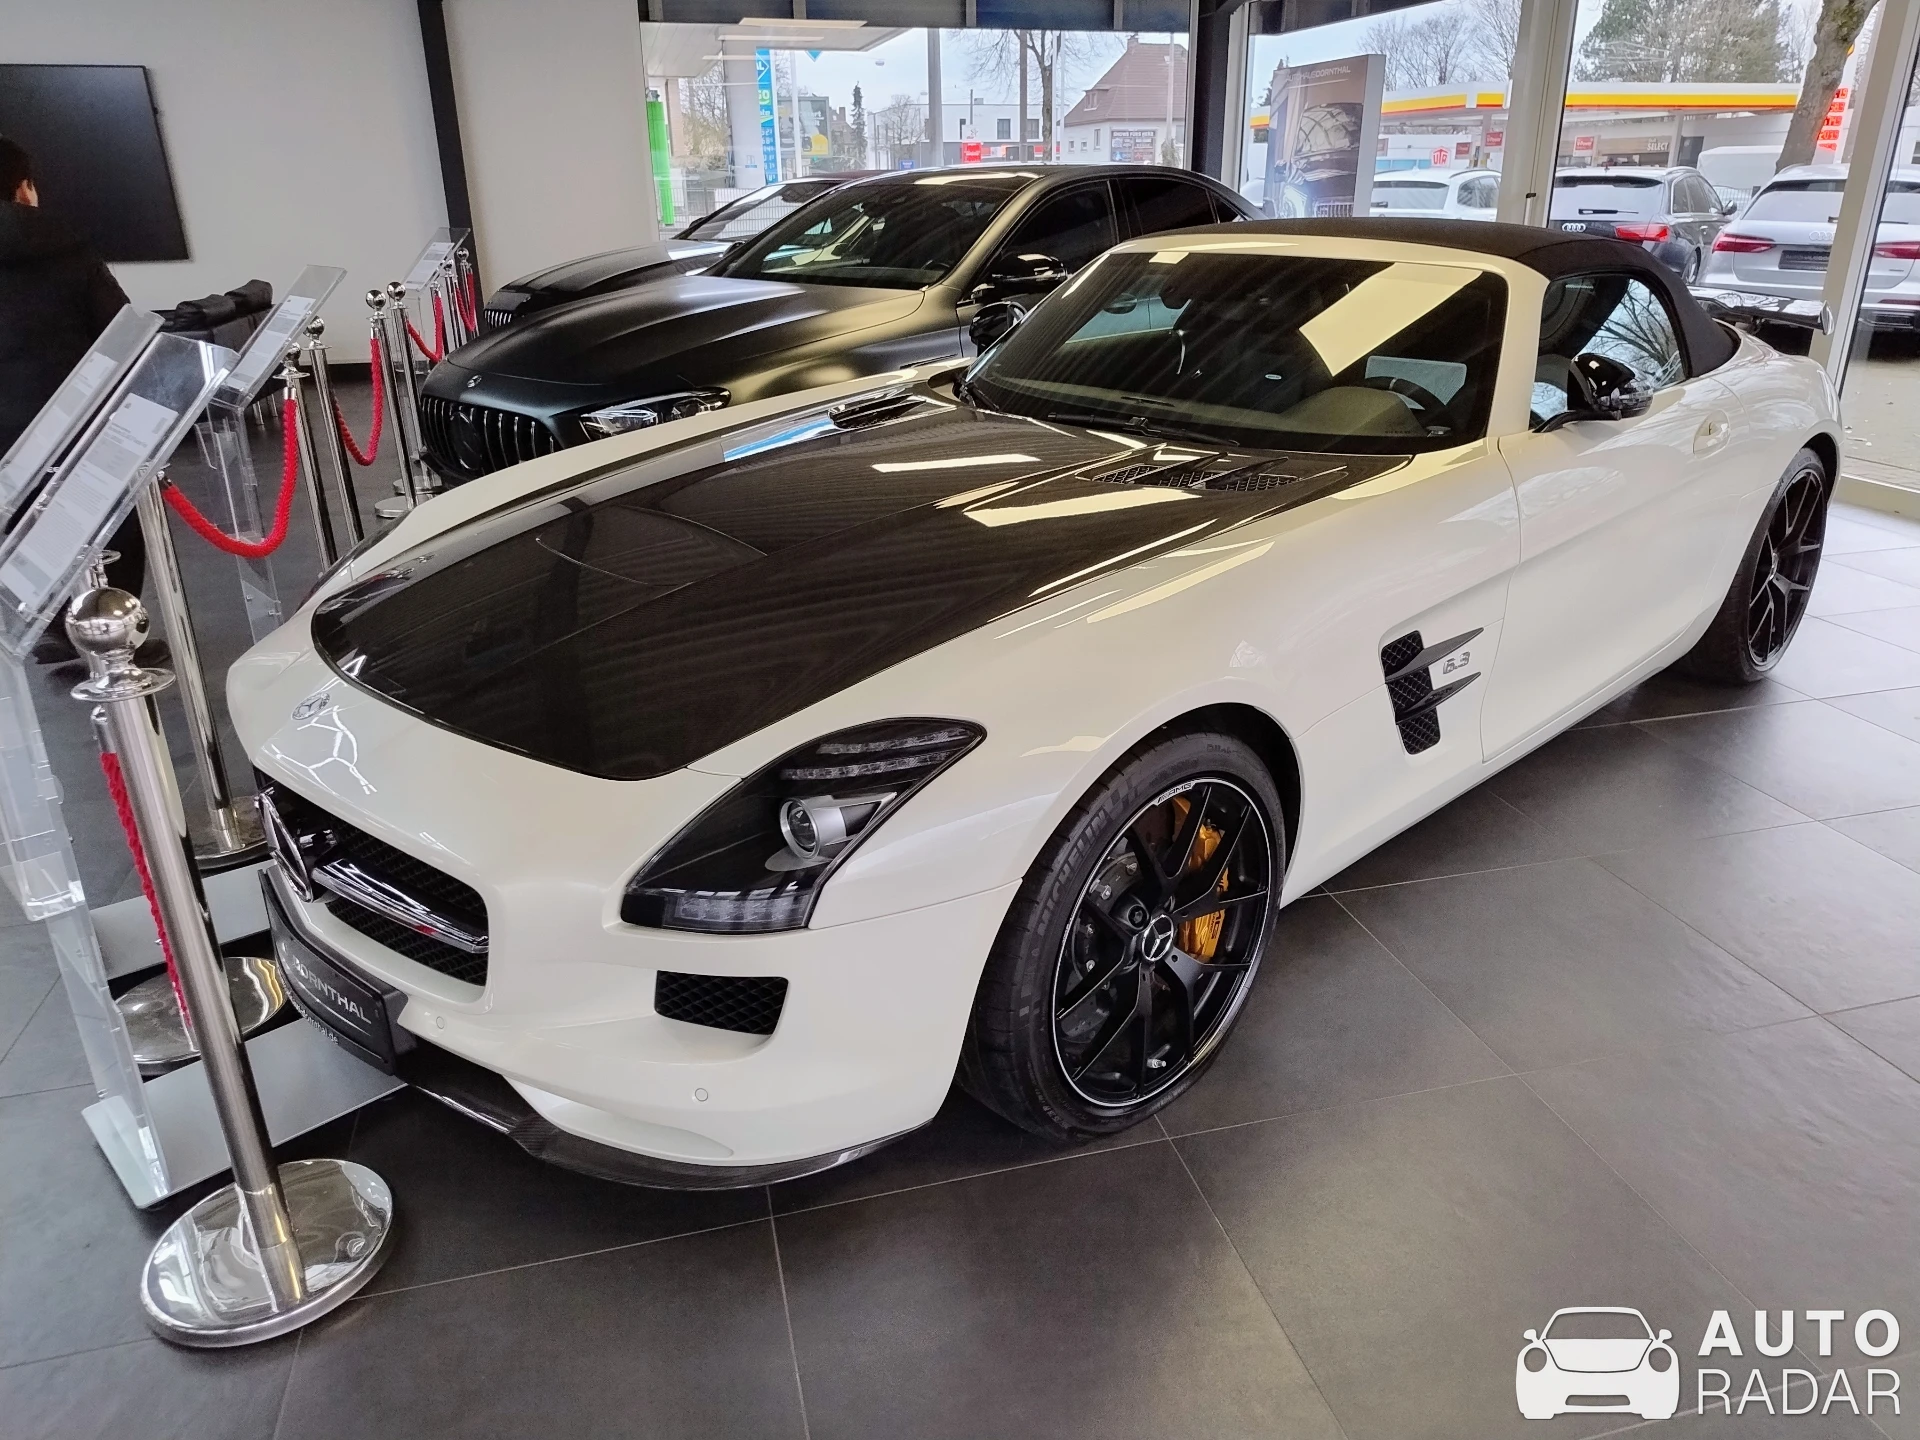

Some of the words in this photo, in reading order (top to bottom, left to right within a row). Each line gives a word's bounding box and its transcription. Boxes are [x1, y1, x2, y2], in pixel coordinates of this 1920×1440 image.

[1646, 142, 1669, 151] SELECT
[1442, 651, 1471, 675] 6.3
[1036, 805, 1108, 937] MICHELIN
